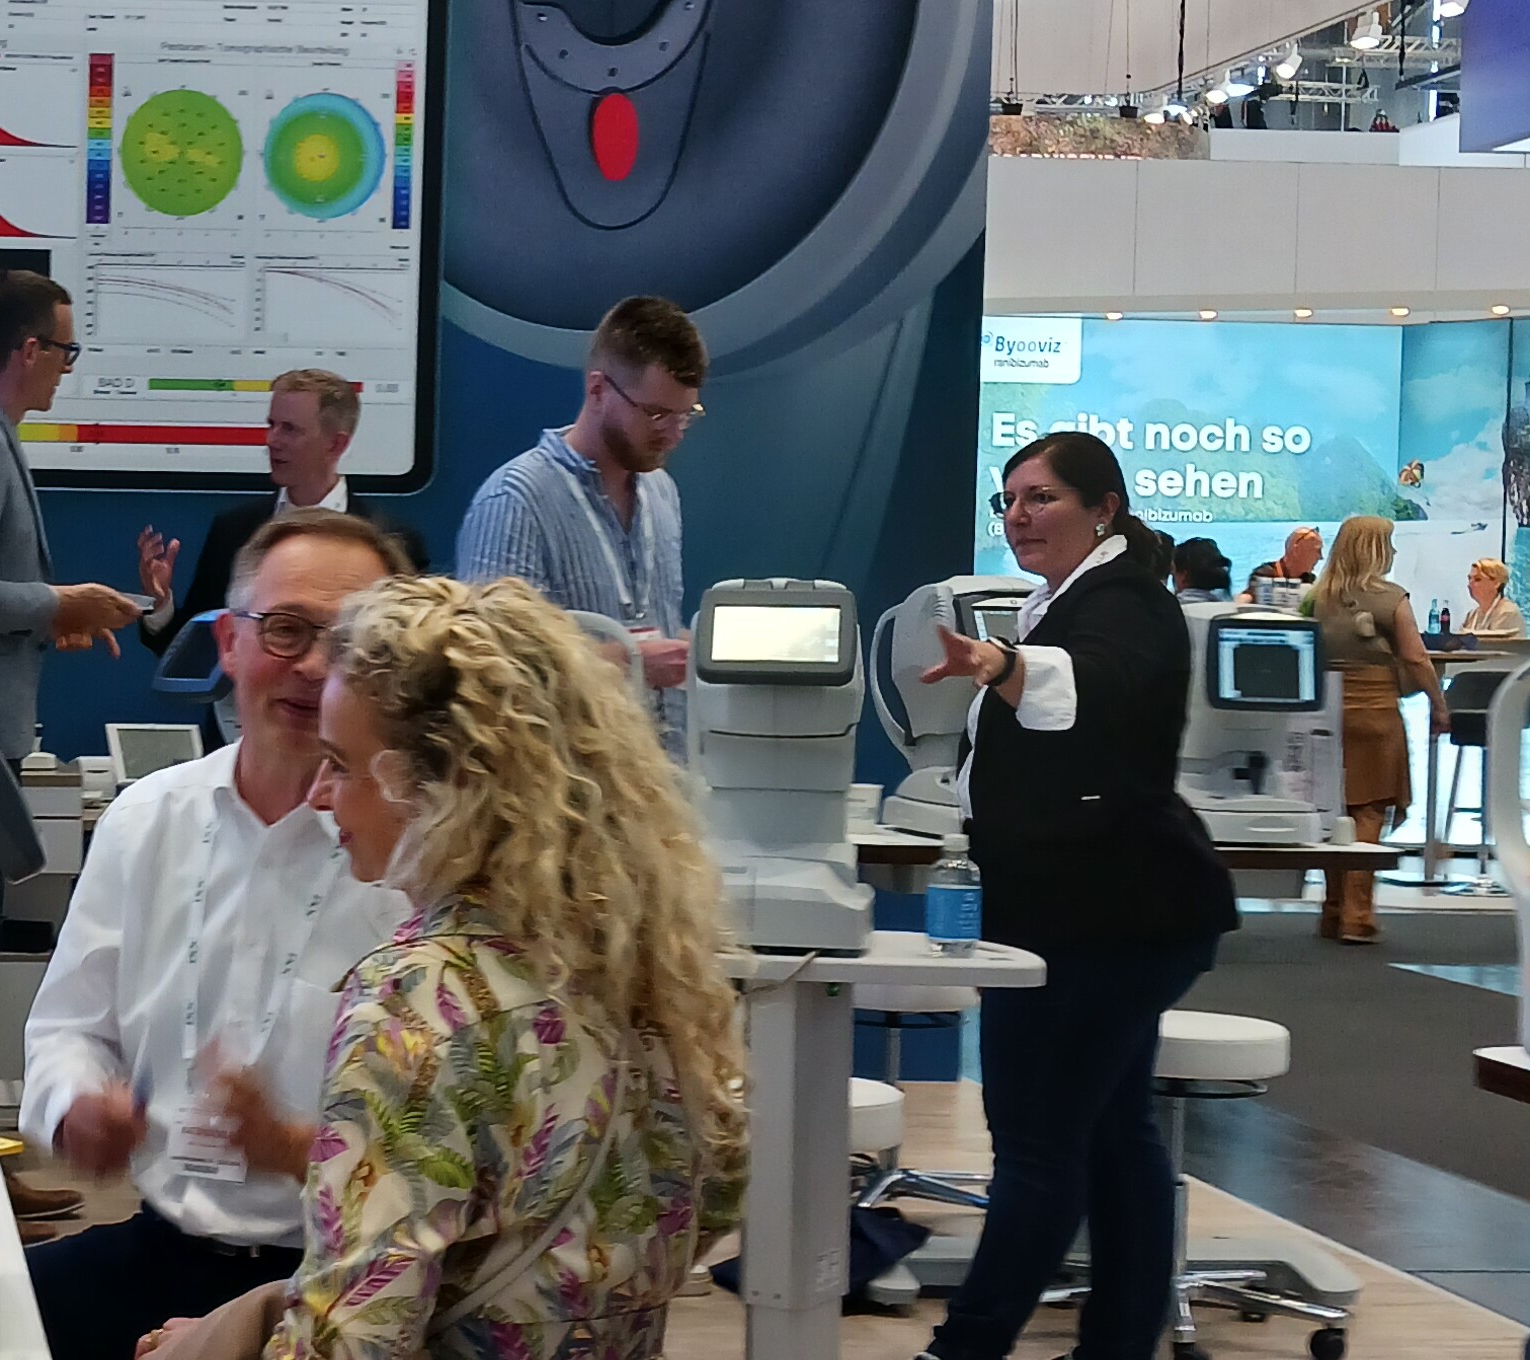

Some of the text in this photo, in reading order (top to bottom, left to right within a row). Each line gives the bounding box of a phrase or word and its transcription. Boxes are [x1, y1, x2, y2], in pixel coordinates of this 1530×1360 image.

[994, 335, 1062, 356] Byooviz
[991, 412, 1039, 448] Es
[1144, 416, 1252, 453] noch
[1262, 424, 1312, 455] so
[1134, 463, 1264, 499] sehen
